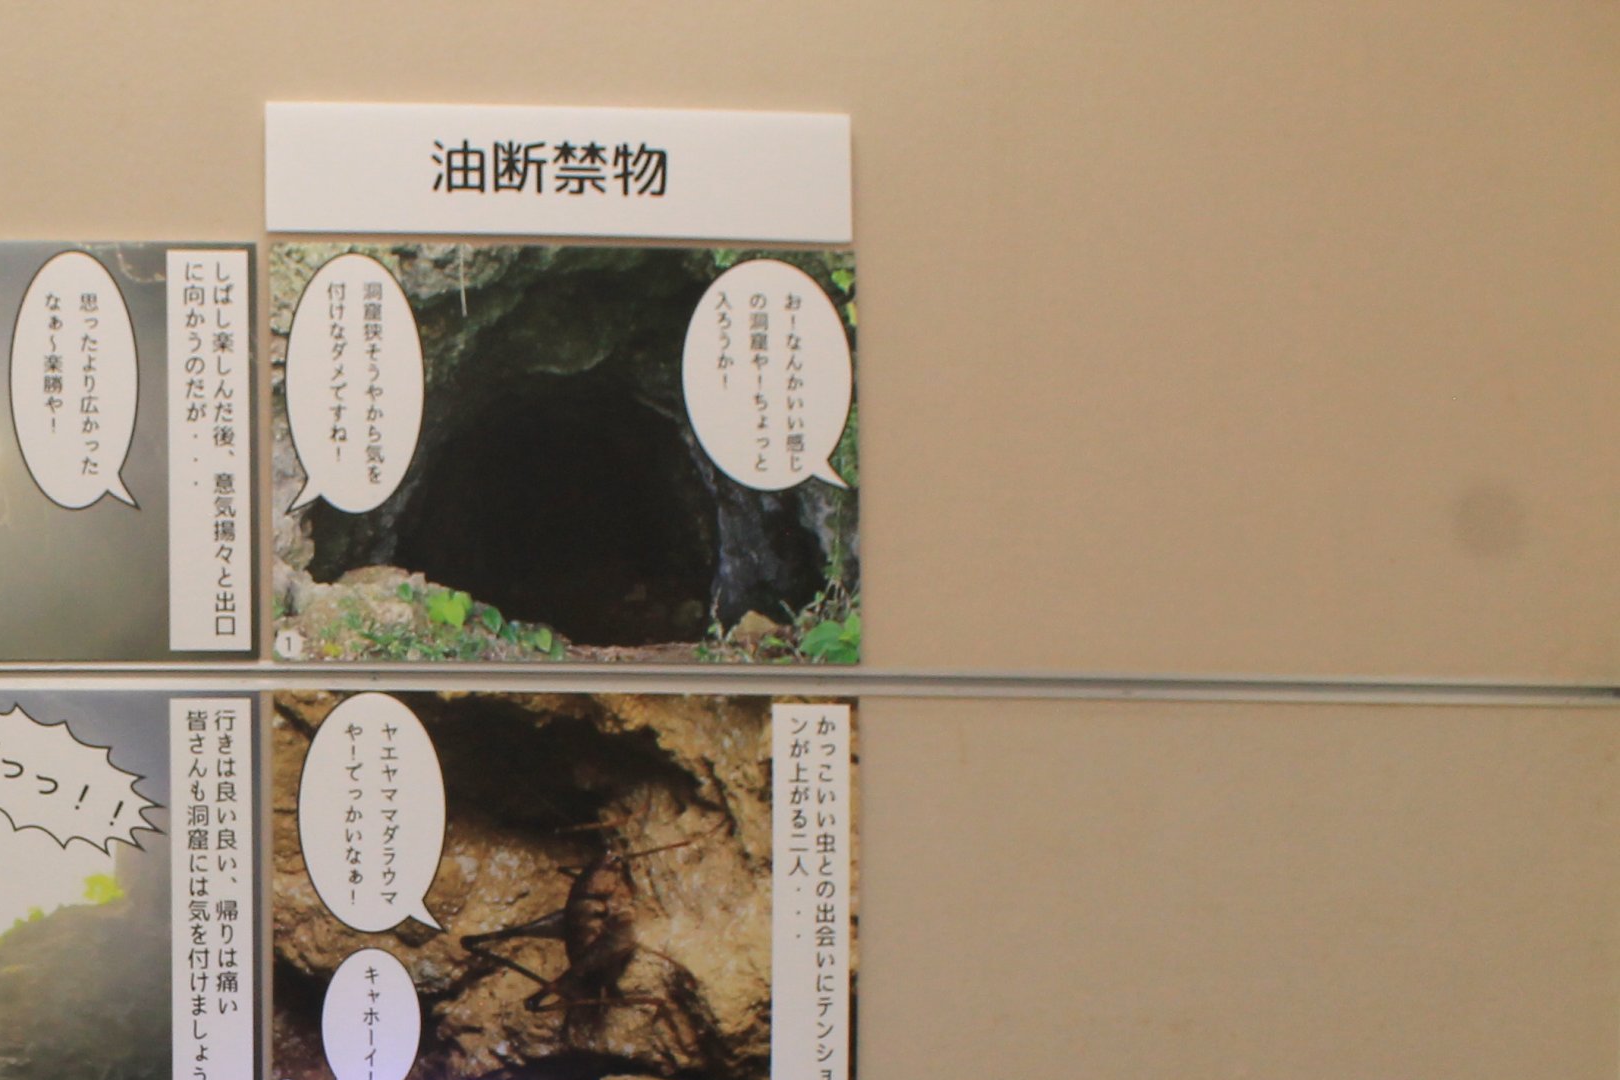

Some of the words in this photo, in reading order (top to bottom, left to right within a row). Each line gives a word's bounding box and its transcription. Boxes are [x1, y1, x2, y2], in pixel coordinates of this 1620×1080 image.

[431, 138, 668, 198] 油断禁物
[79, 292, 101, 476] 思ったより広かった
[326, 281, 349, 462] 付けなダメですね！
[362, 281, 386, 485] 洞窟狭そうやから気を
[714, 291, 735, 389] 入ろうか！
[212, 261, 237, 637] しばし楽しんだ後、意気揚々と出口
[285, 636, 292, 652] 1
[213, 709, 239, 1015] 行きは良い良い、帰りは痛い
[344, 722, 364, 905] や！でっかいなぁ！
[379, 722, 401, 906] ヤエヤママダラウマ
